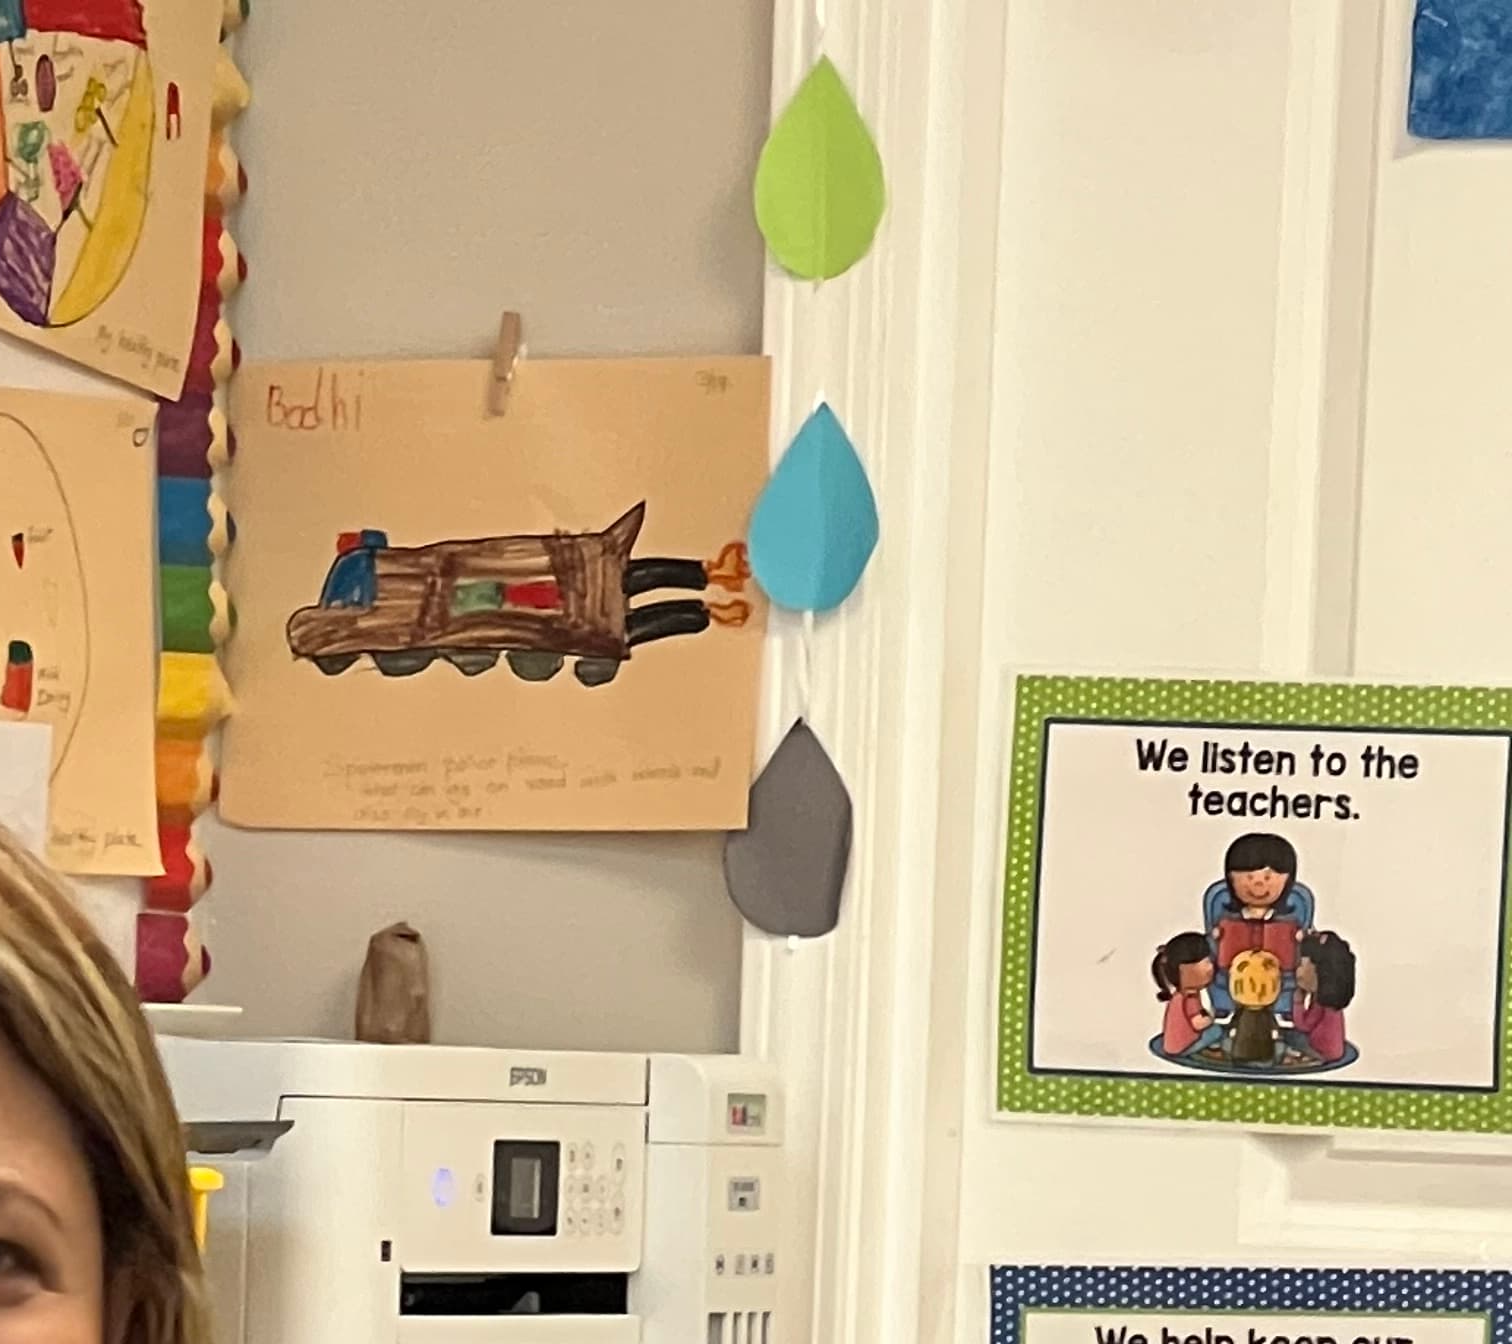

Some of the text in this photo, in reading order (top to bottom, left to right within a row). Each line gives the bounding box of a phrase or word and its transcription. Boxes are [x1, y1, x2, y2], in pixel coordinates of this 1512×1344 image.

[267, 366, 365, 432] Bodhi
[1136, 738, 1420, 780] We listen to the
[1187, 782, 1361, 820] teachers.
